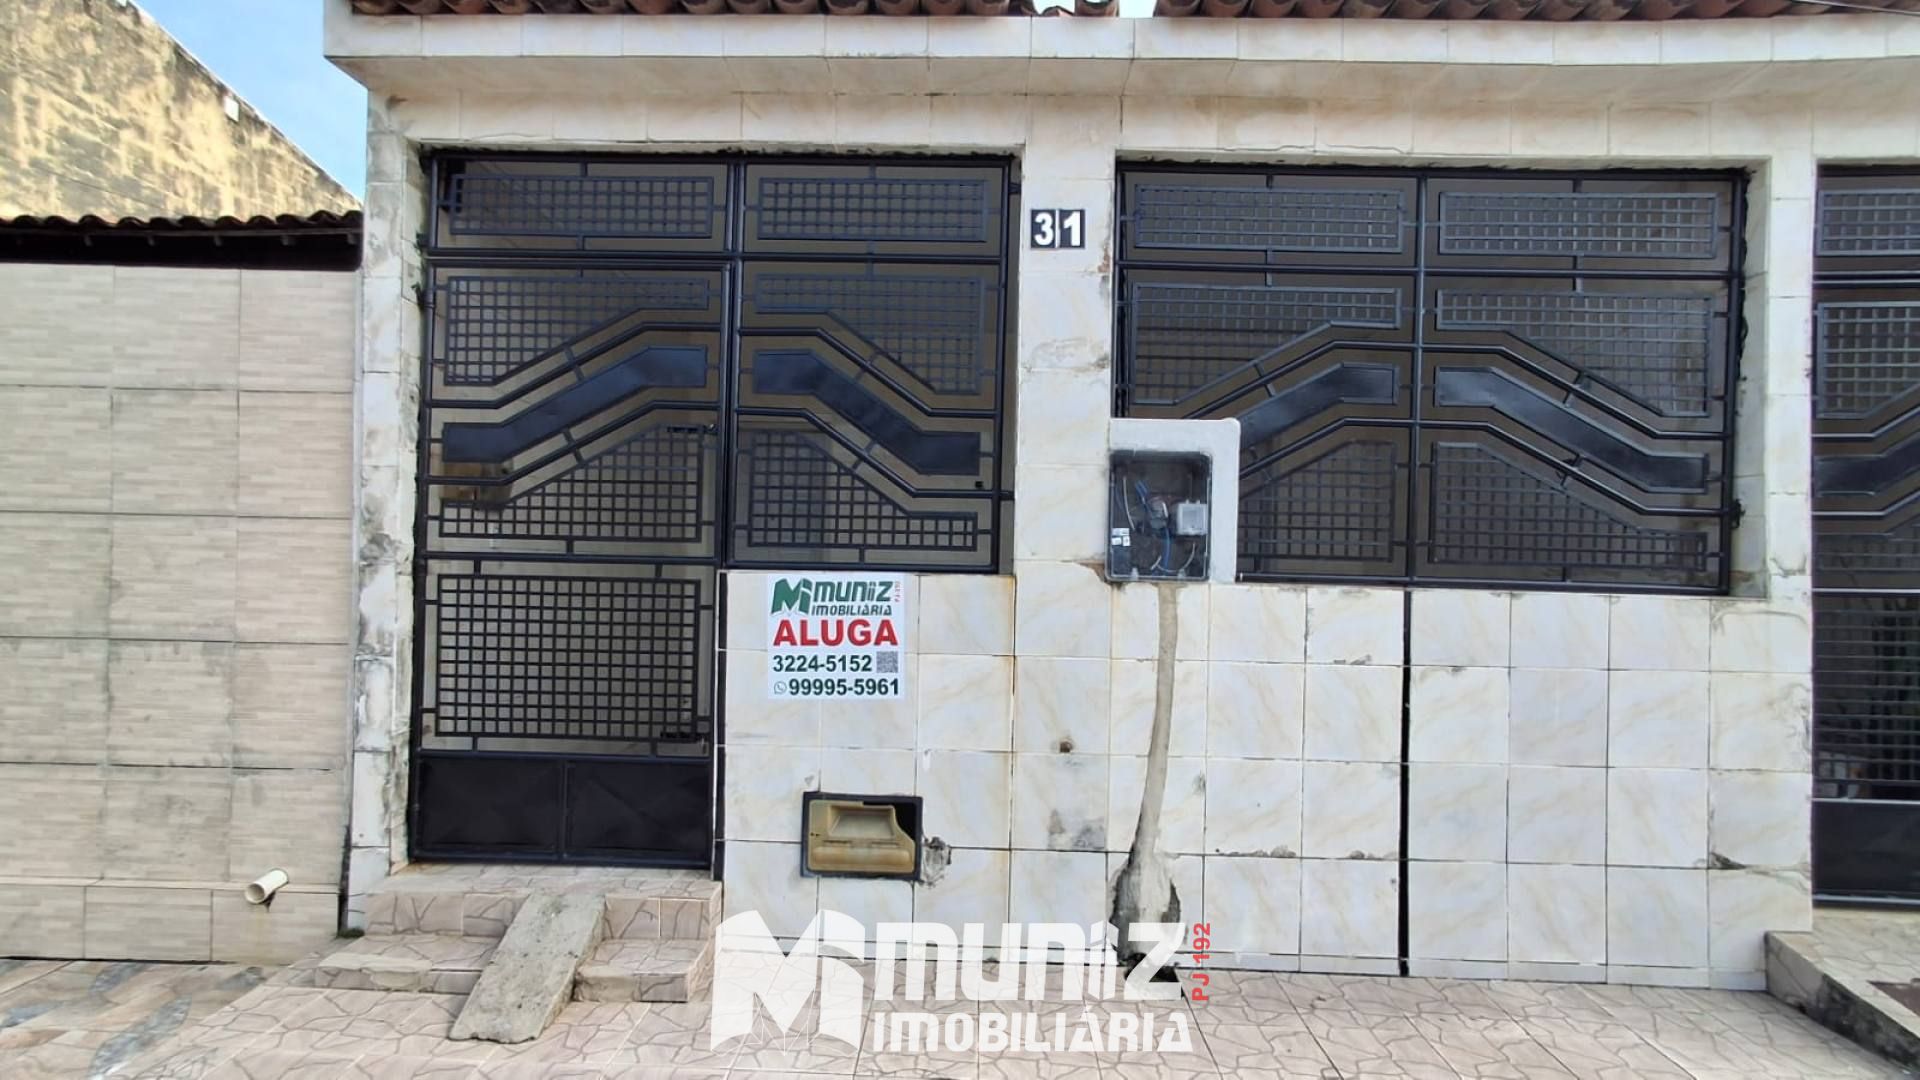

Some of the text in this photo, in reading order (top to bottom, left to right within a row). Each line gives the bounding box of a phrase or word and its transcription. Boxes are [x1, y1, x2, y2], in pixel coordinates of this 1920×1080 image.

[1034, 211, 1081, 247] 31
[773, 619, 898, 646] ALUGA
[773, 655, 872, 672] 3224-5152
[789, 678, 899, 696] 99995-5961
